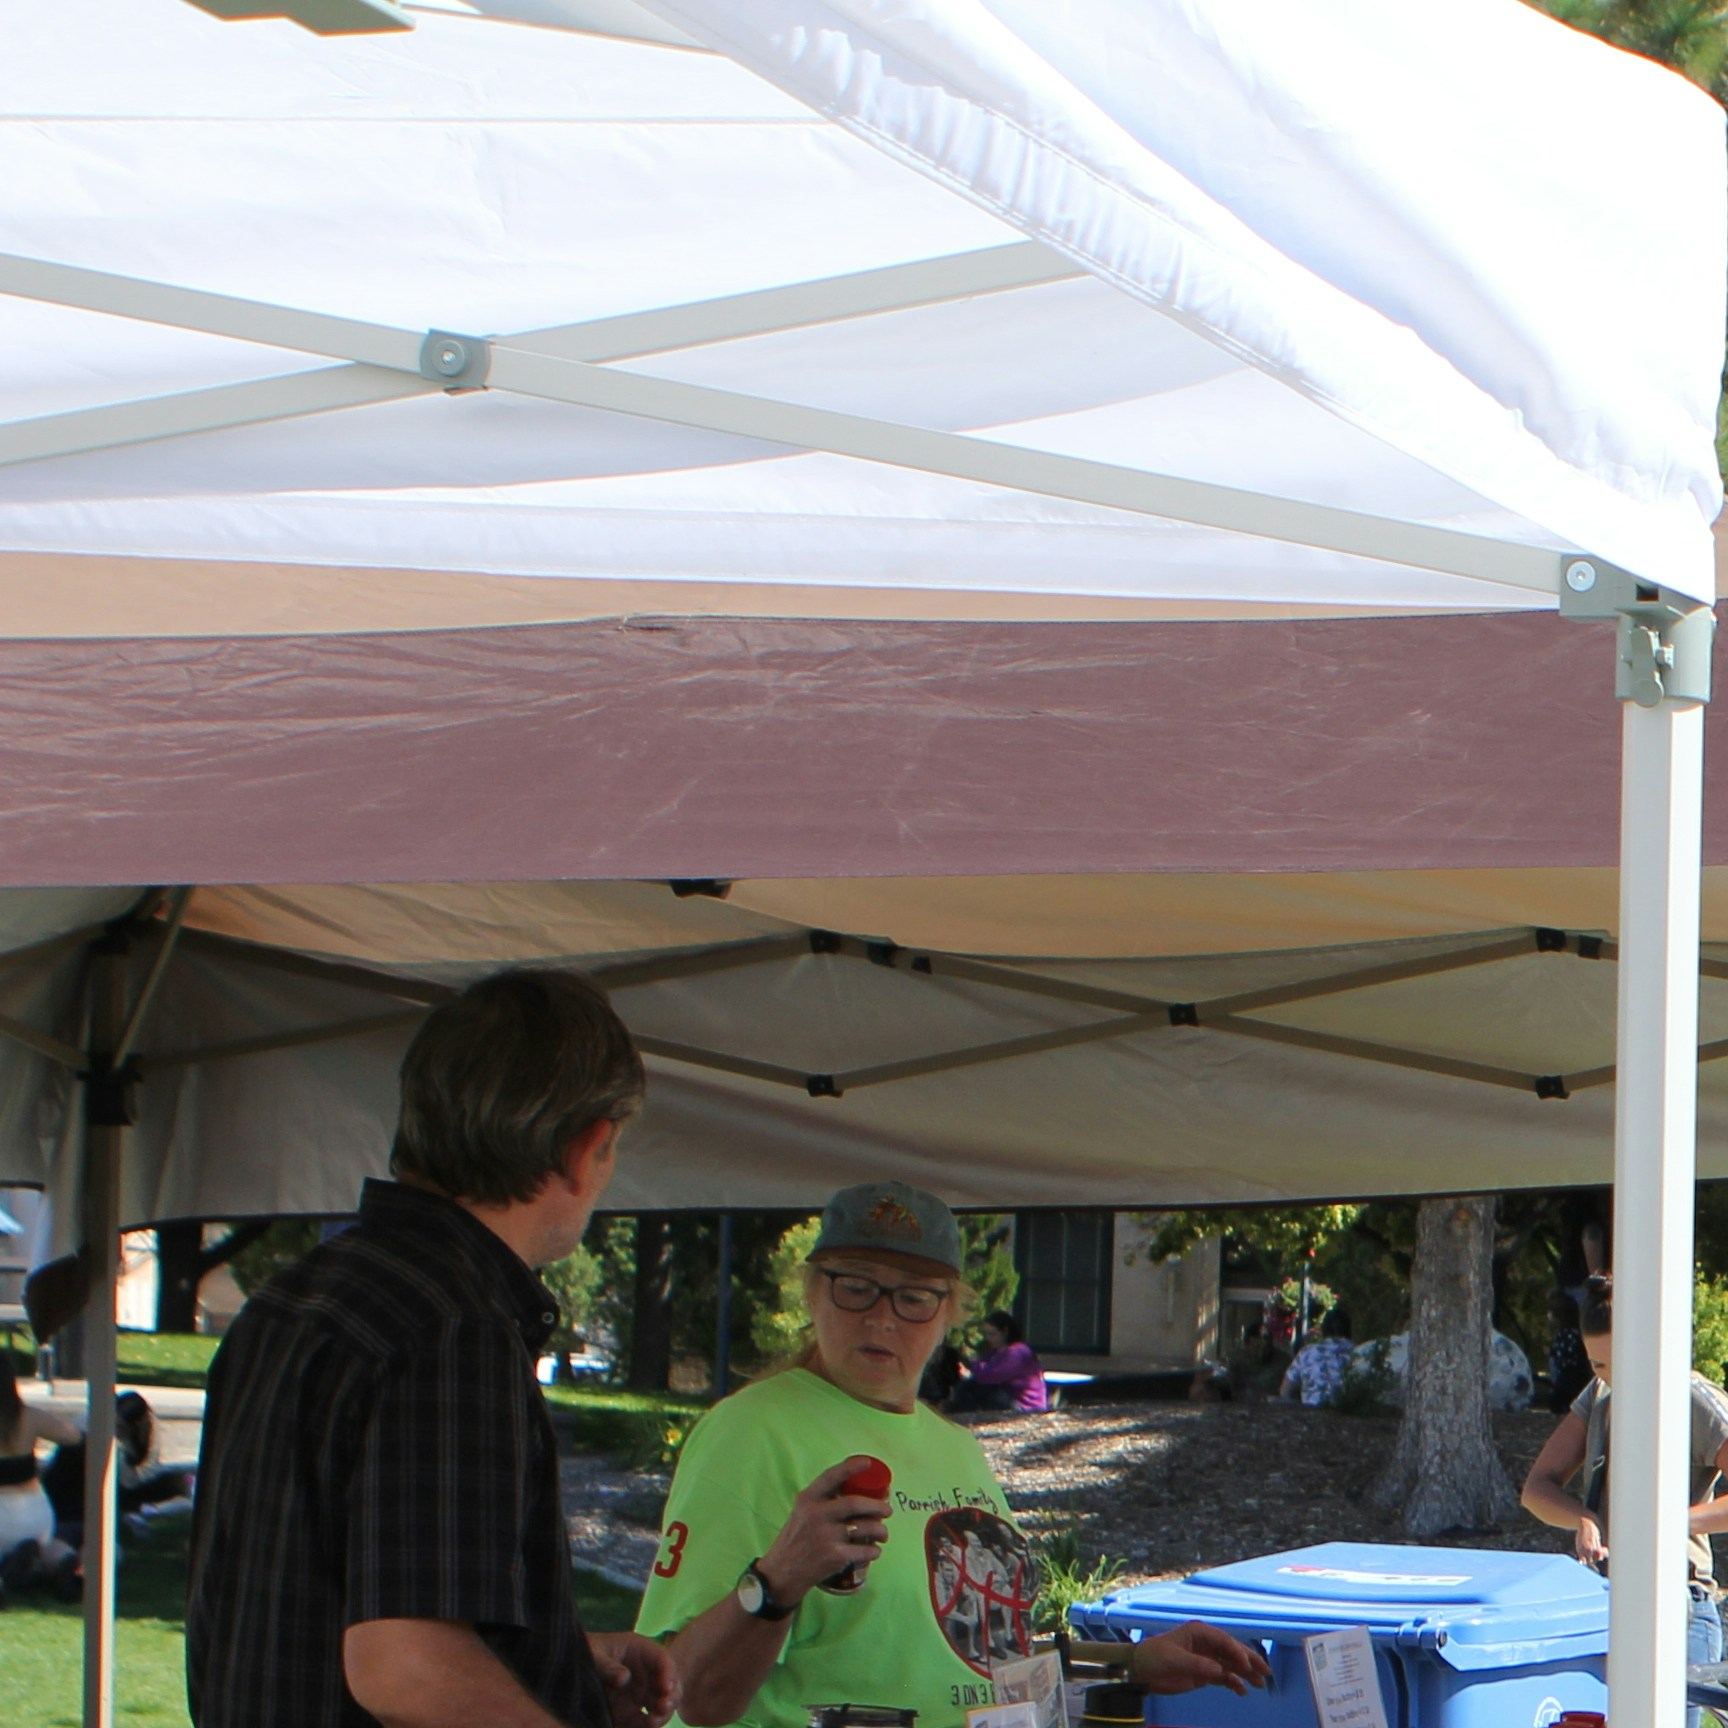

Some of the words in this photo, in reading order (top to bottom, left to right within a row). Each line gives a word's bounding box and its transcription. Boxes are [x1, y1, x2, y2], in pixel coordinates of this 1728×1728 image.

[895, 1491, 949, 1512] Parrish
[953, 1487, 997, 1513] Family
[654, 1521, 689, 1578] 3
[951, 1685, 959, 1706] 3
[964, 1684, 977, 1706] ON
[981, 1683, 988, 1704] 3
